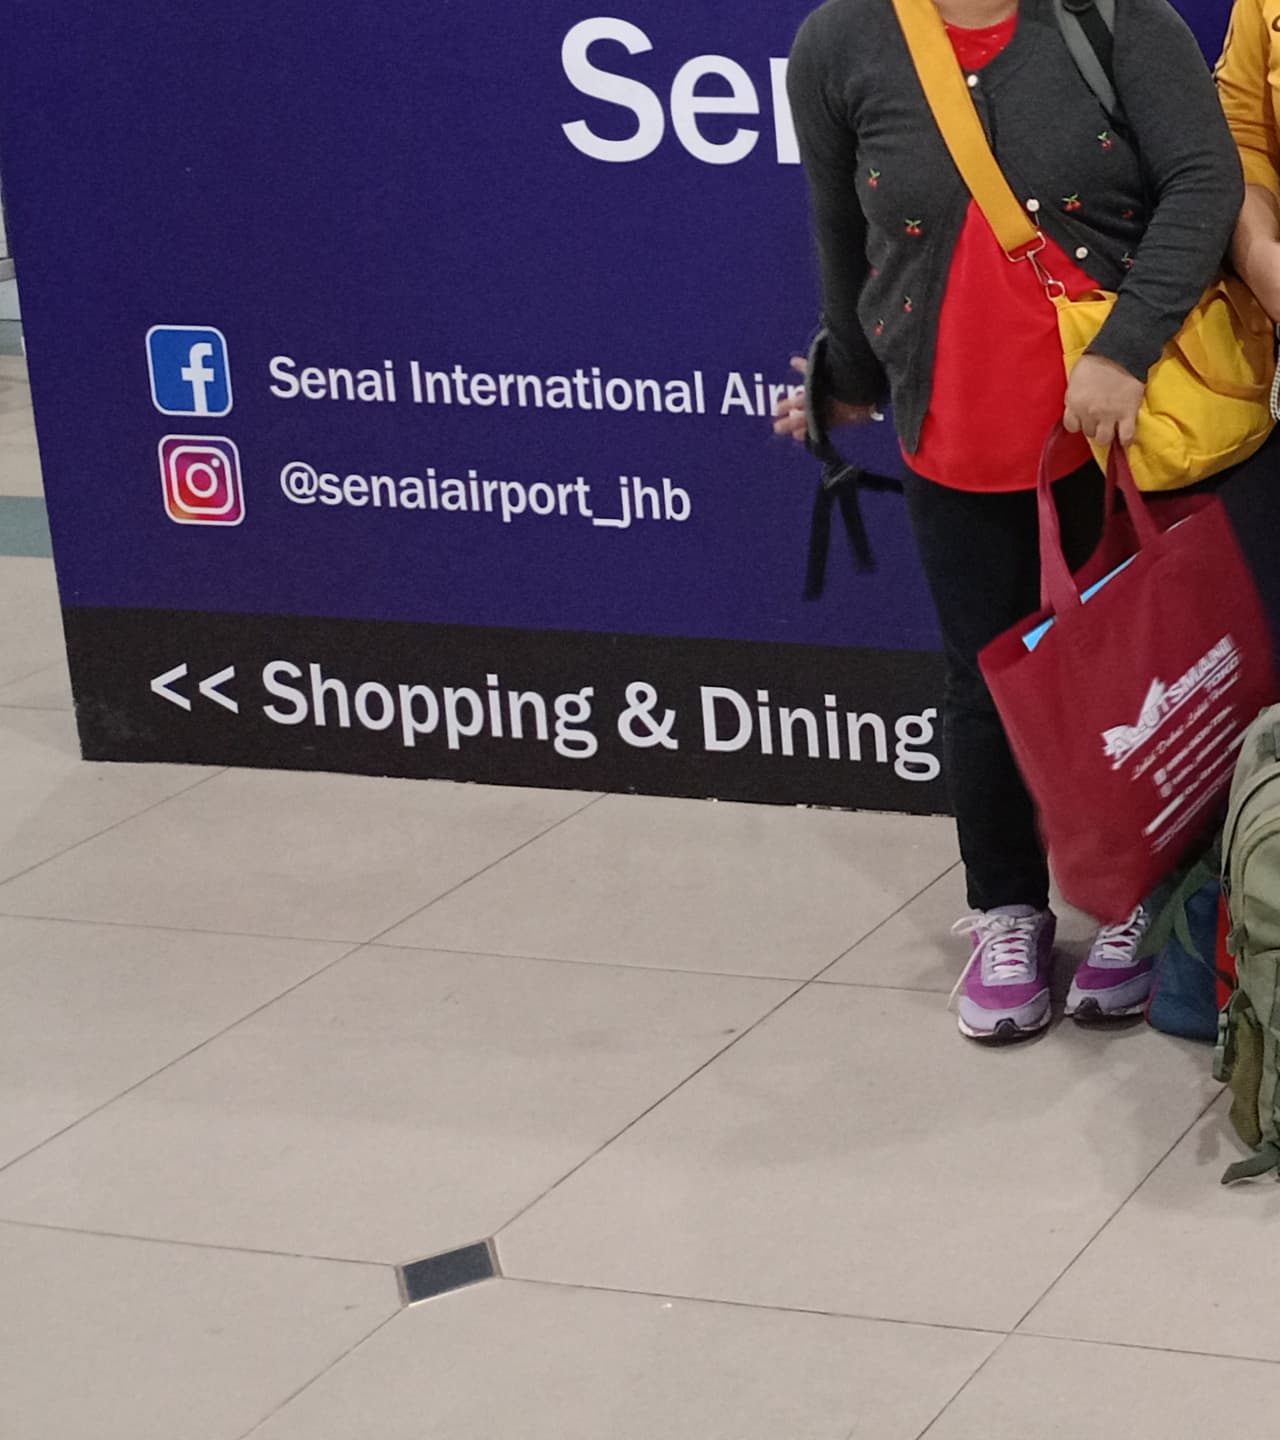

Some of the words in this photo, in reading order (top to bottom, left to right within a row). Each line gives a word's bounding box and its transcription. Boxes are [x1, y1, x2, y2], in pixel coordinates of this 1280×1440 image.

[268, 355, 397, 403] Senai
[409, 360, 706, 416] International
[279, 460, 692, 529] @senaiairport_jhb
[261, 660, 600, 760] Shopping
[616, 680, 679, 750] &
[700, 685, 942, 782] Dining
